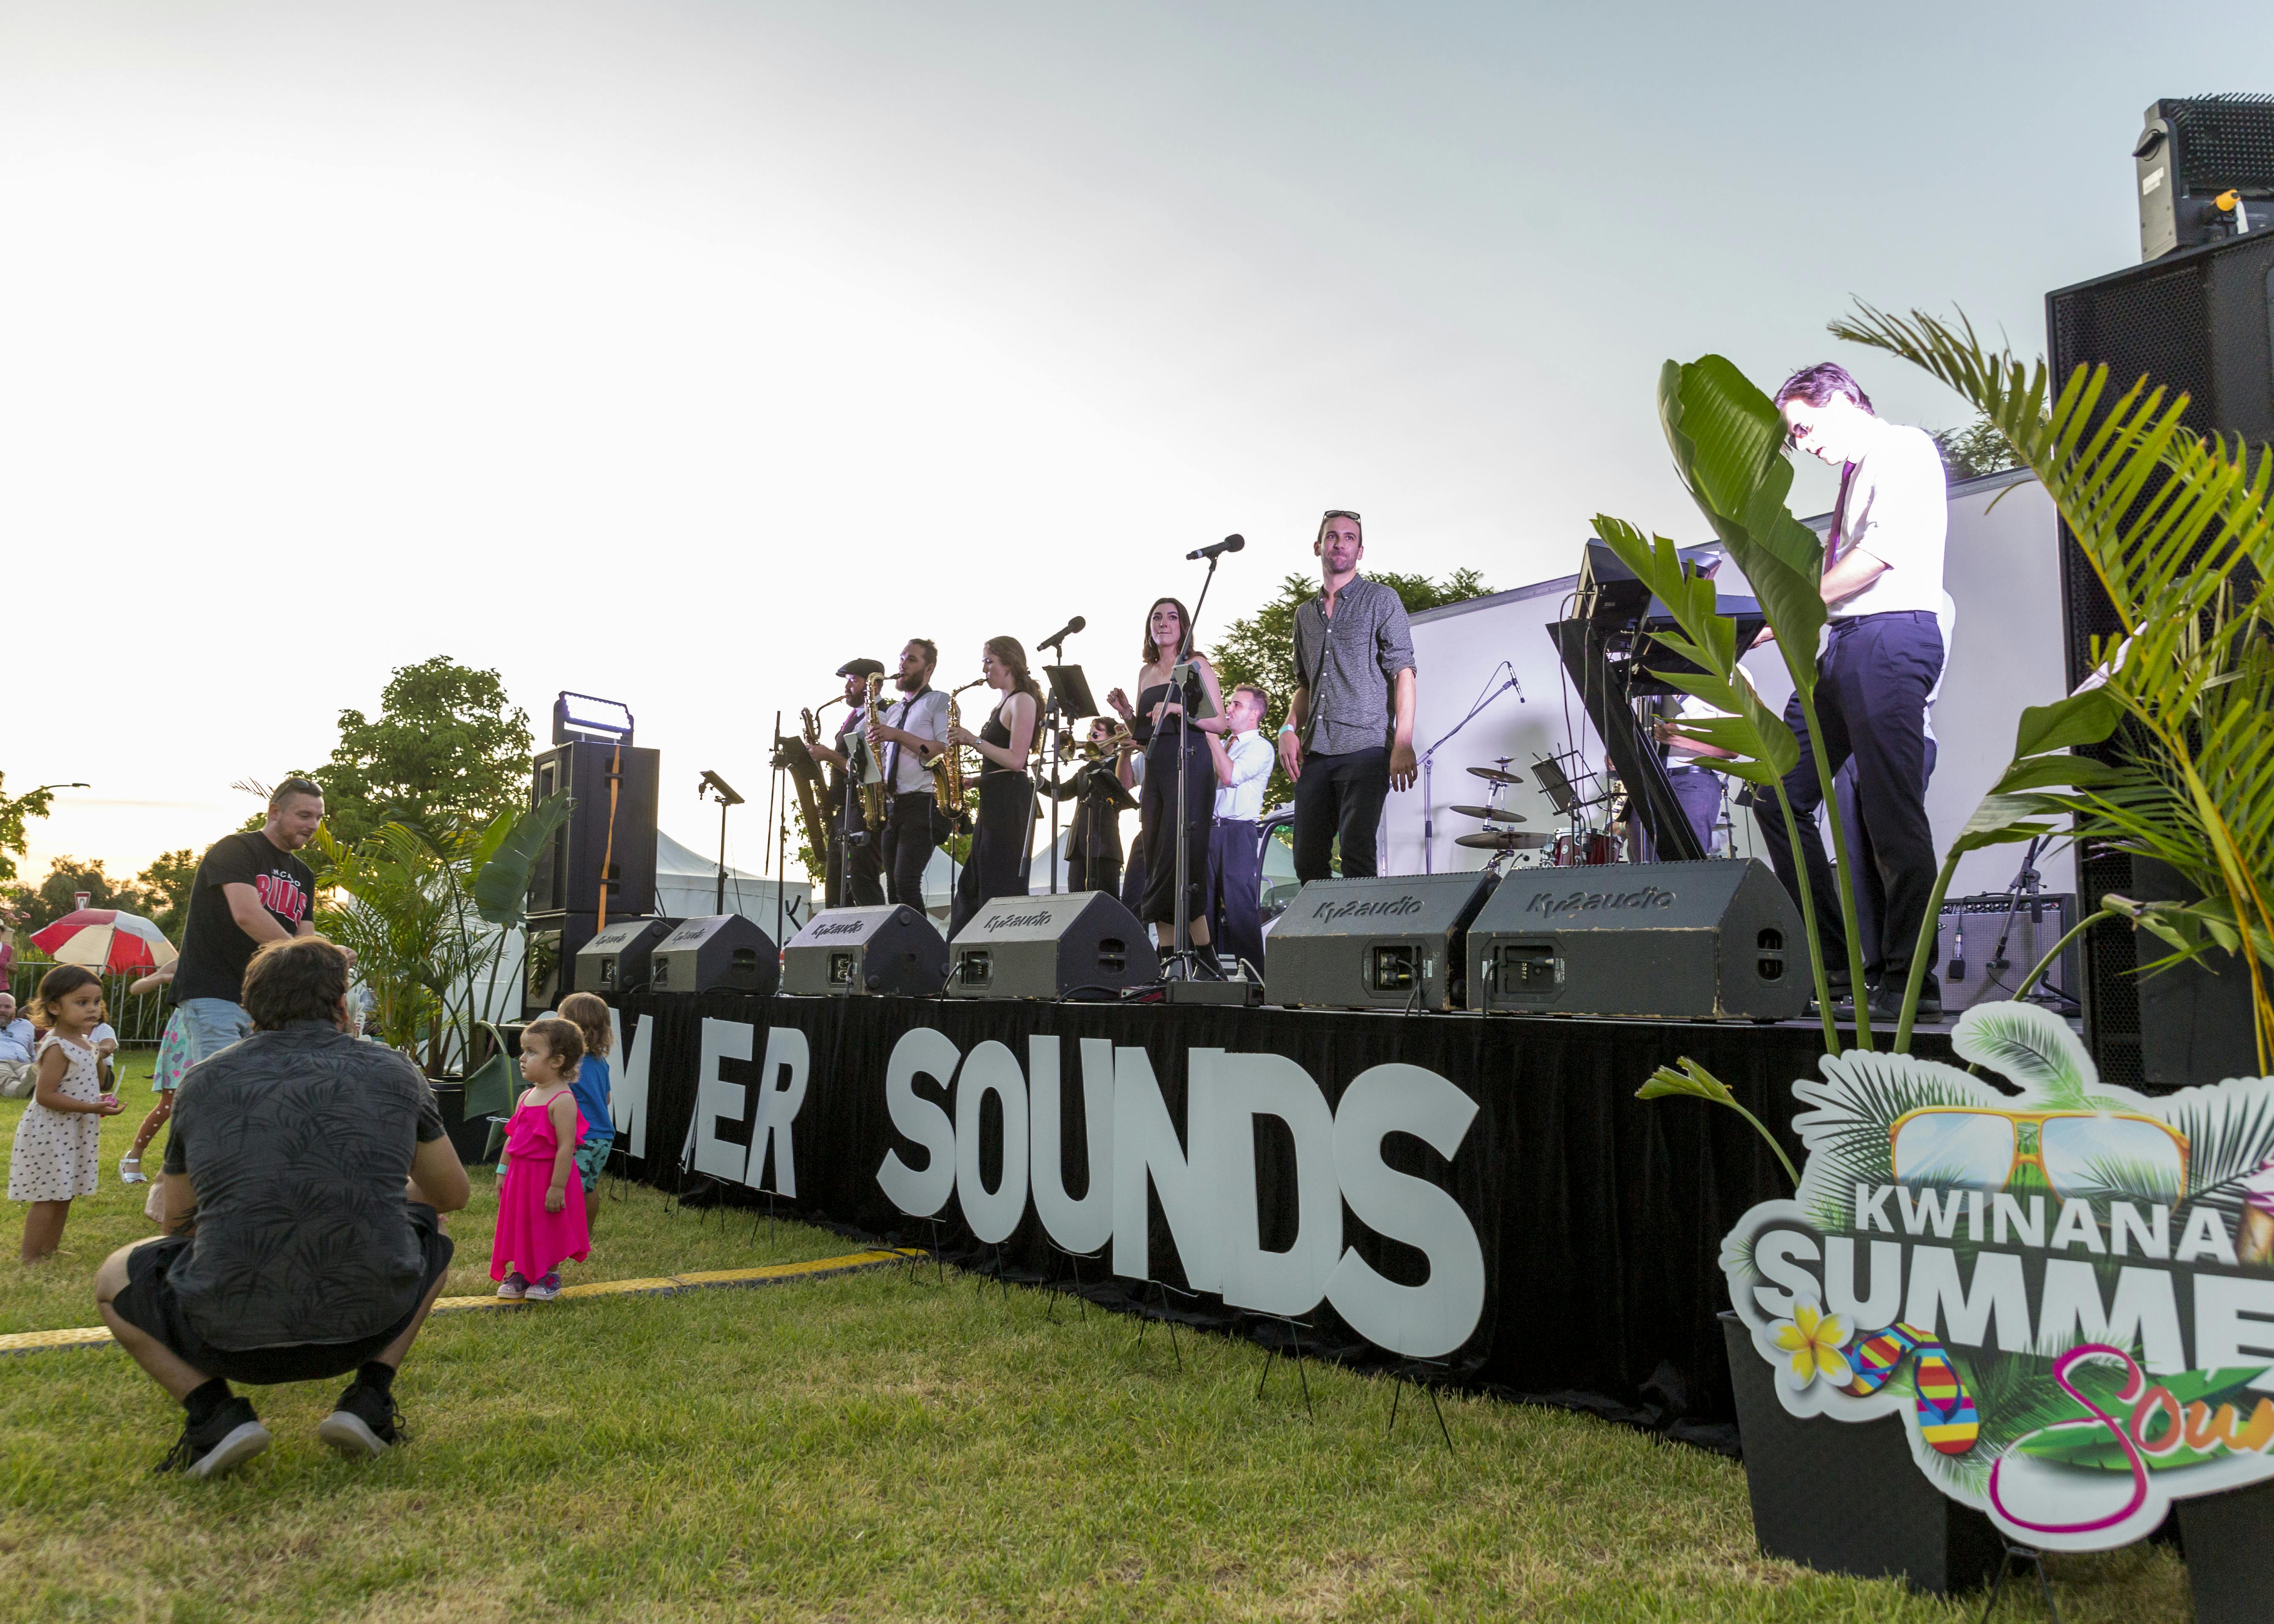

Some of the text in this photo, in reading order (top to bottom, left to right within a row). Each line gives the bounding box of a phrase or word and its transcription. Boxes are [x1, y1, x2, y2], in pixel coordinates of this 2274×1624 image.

[255, 874, 308, 928] BULLS
[876, 1027, 1486, 1357] SOUNDS
[1855, 1183, 2239, 1265] KWINANA
